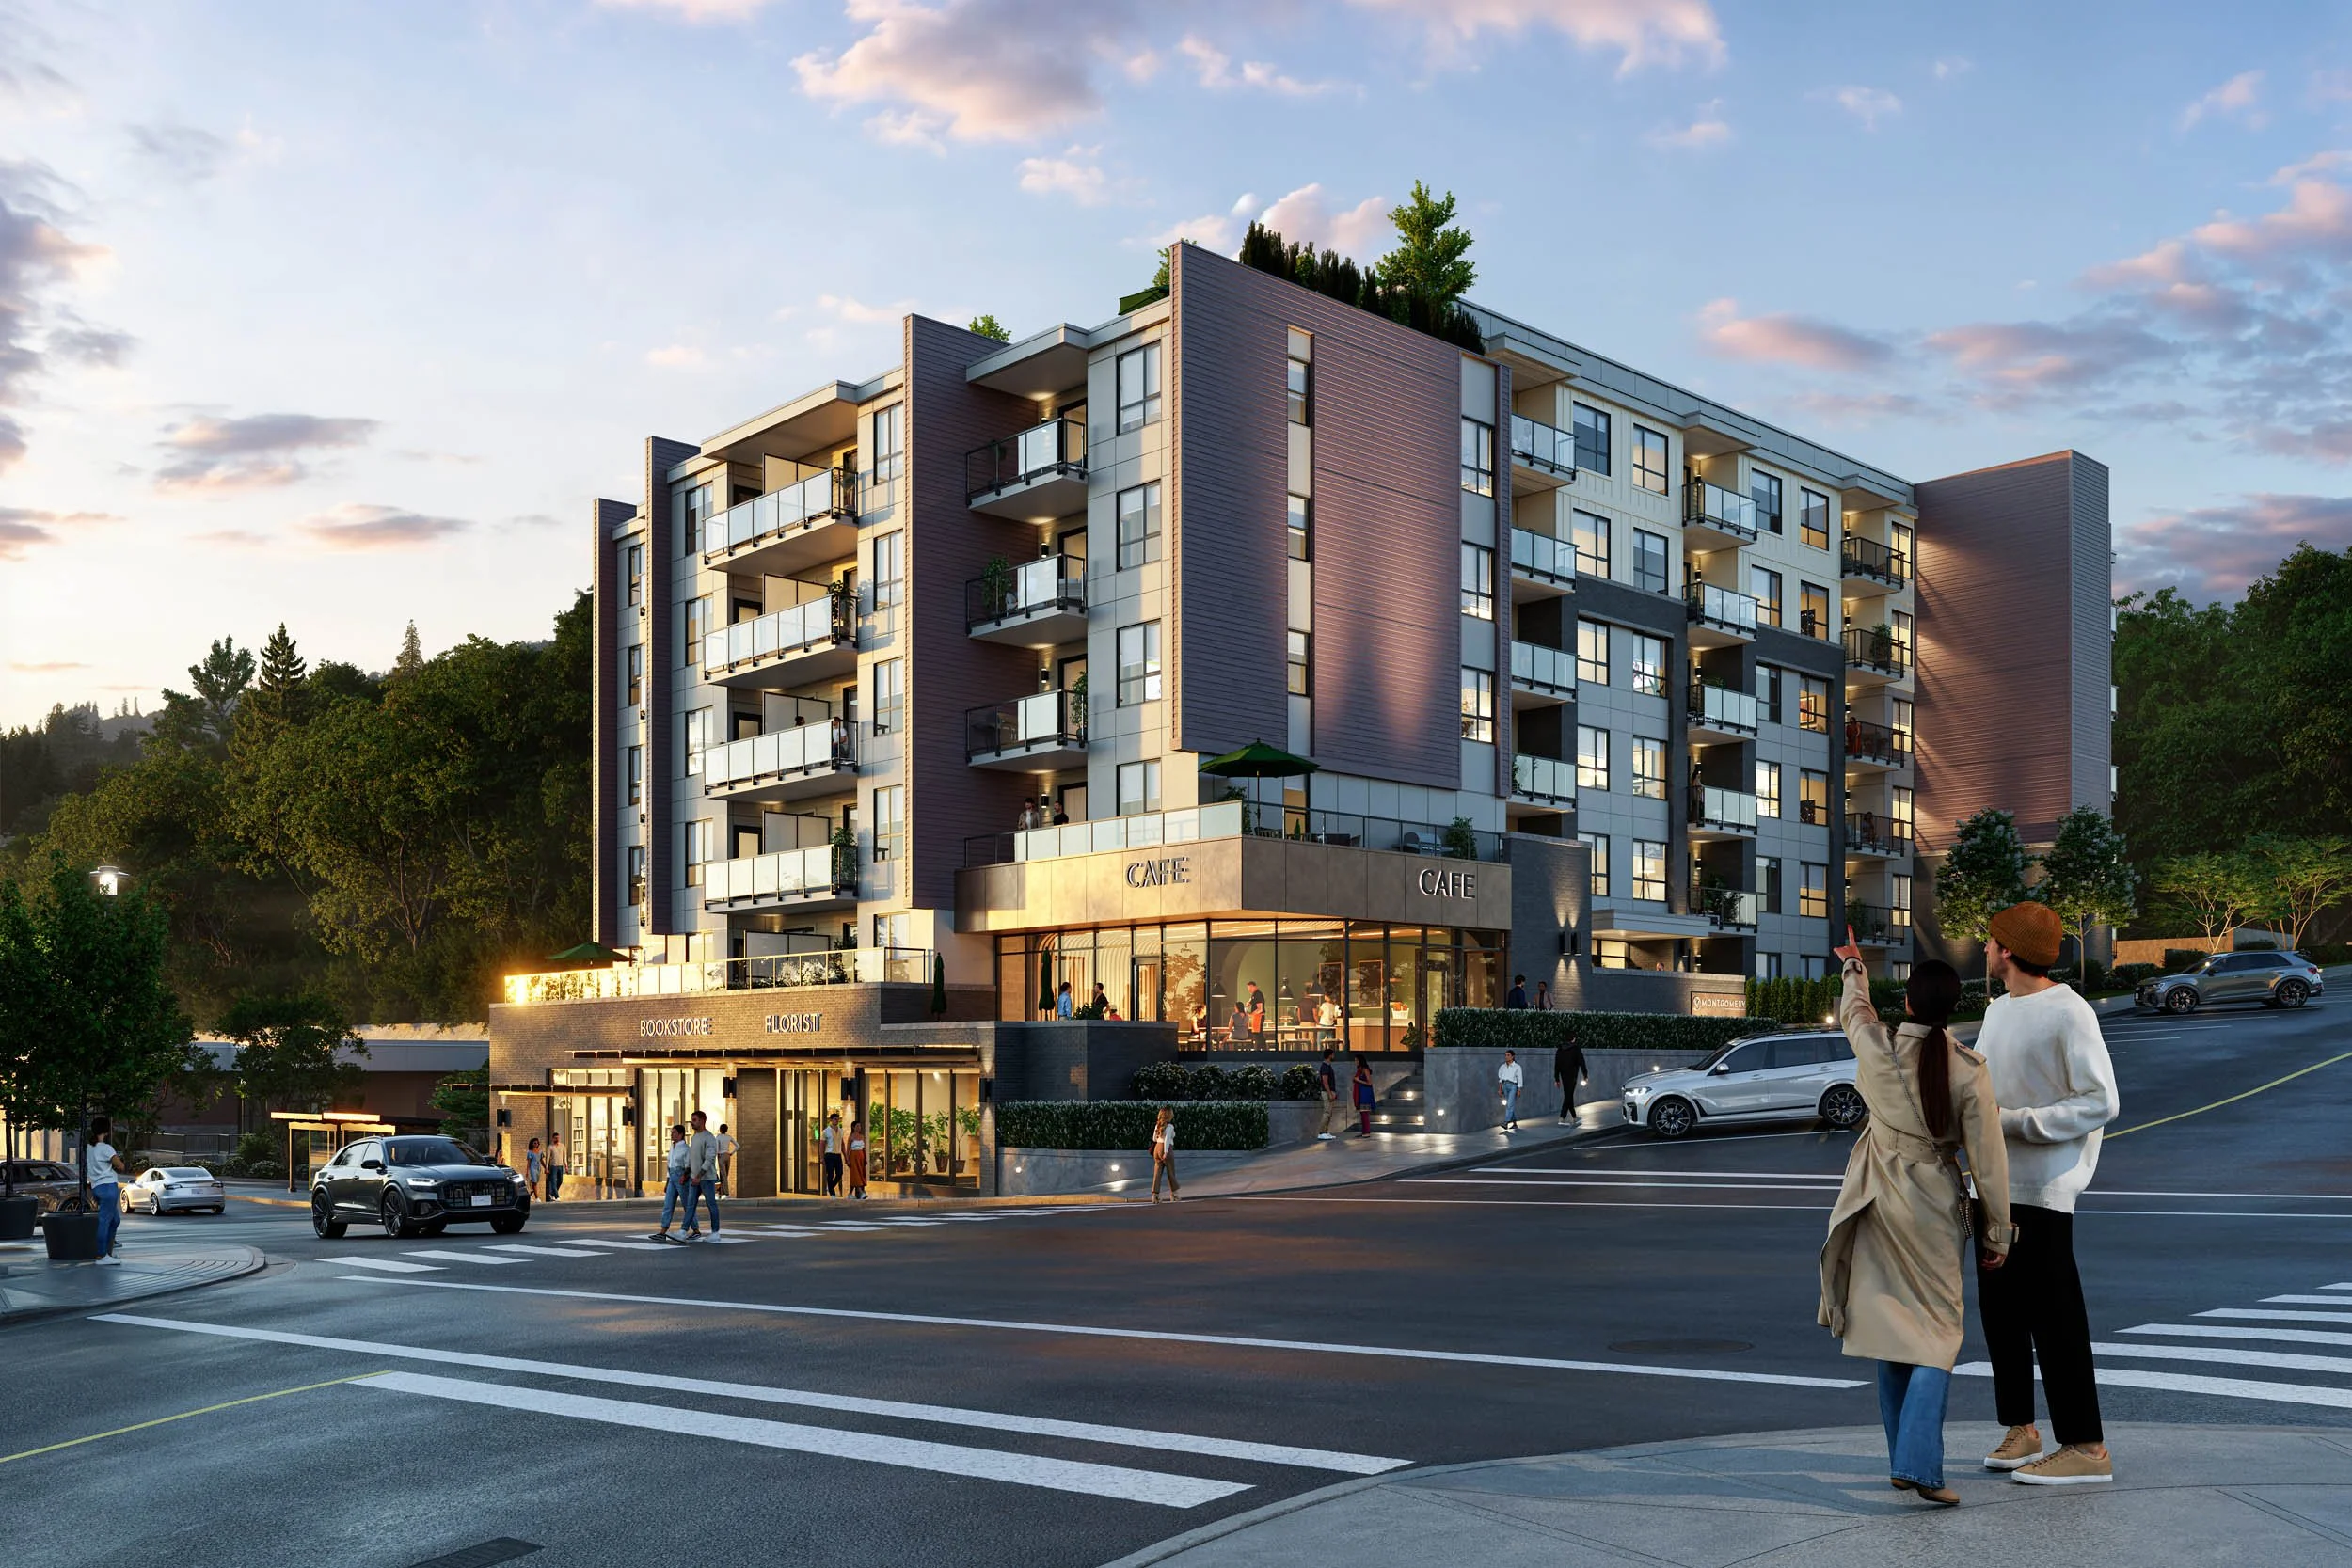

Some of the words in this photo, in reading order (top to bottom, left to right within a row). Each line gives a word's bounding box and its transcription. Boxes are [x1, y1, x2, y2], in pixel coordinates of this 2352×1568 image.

[1126, 857, 1190, 888] CAFE
[1419, 868, 1475, 899] CAFE
[1701, 998, 1746, 1008] MONTGOMERY
[640, 1017, 711, 1037] BOOKSTORE
[765, 1013, 821, 1033] FLORIST
